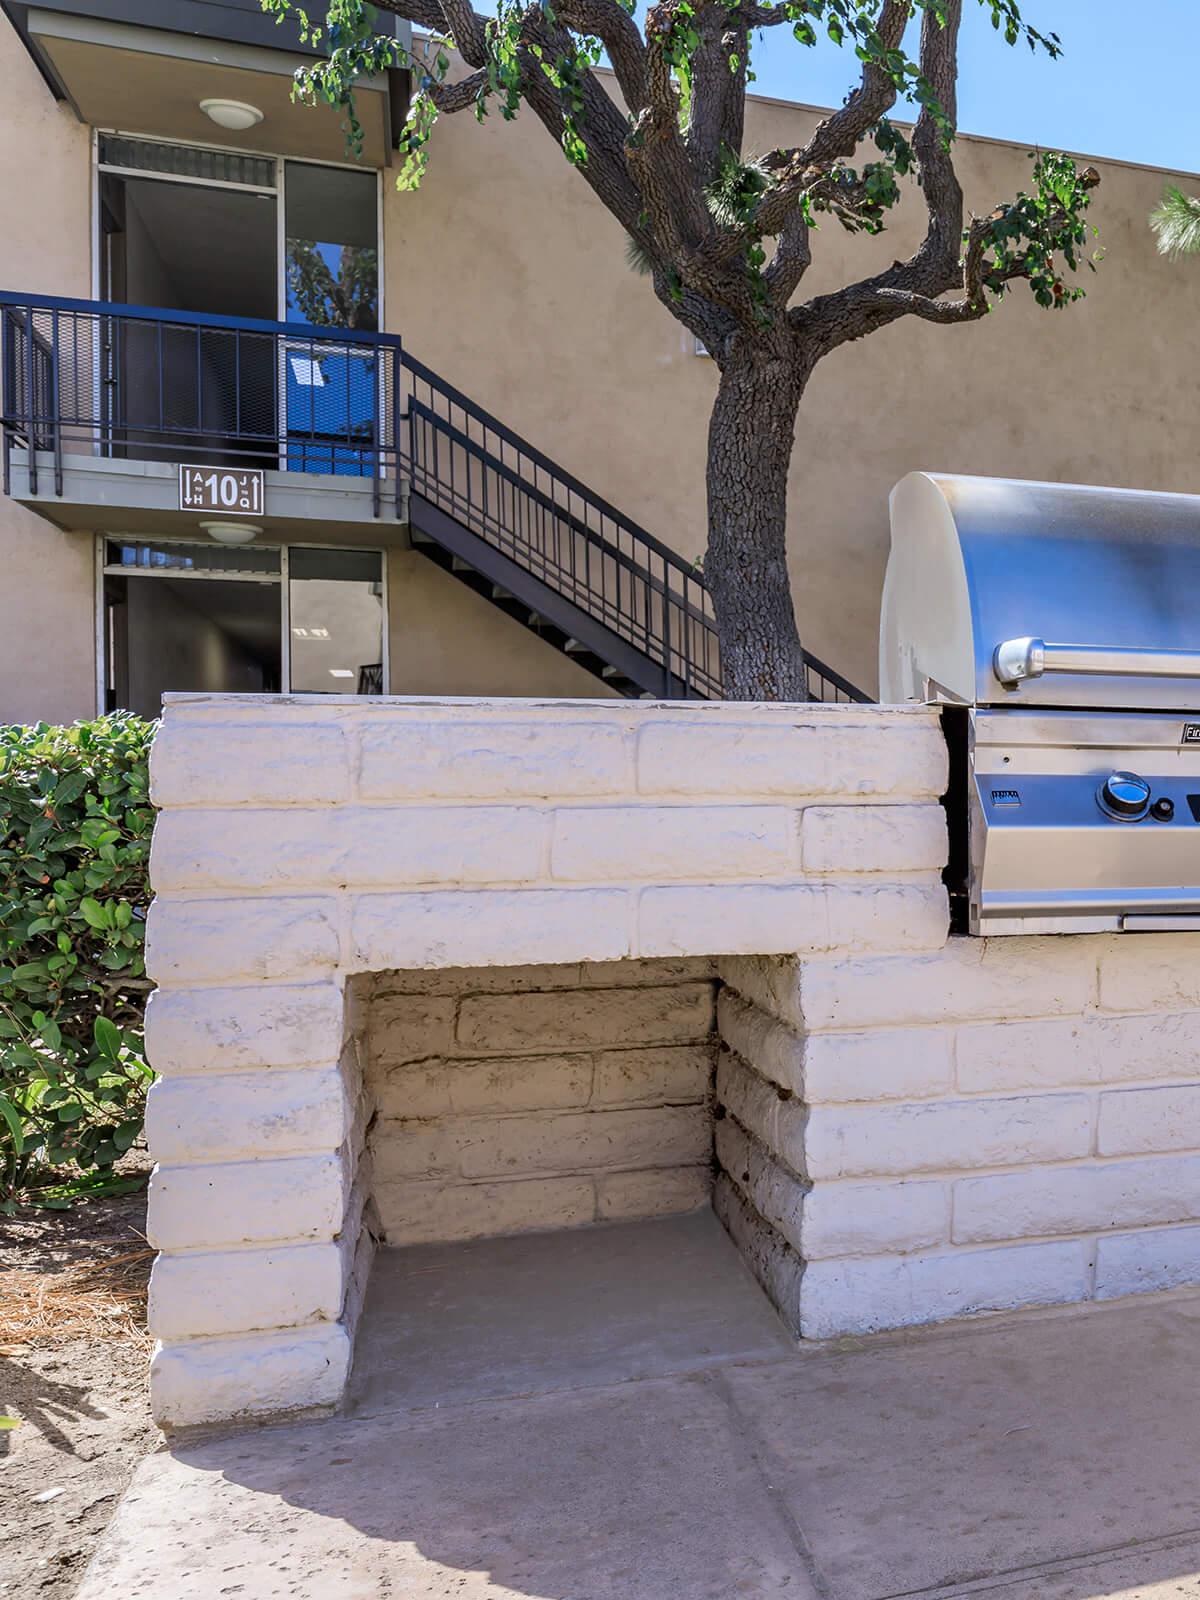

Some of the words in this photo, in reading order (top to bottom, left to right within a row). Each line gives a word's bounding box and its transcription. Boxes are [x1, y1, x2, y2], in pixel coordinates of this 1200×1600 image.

[193, 472, 203, 482] A
[240, 475, 247, 486] J
[205, 473, 238, 506] 10
[193, 494, 203, 505] H
[240, 498, 250, 509] Q
